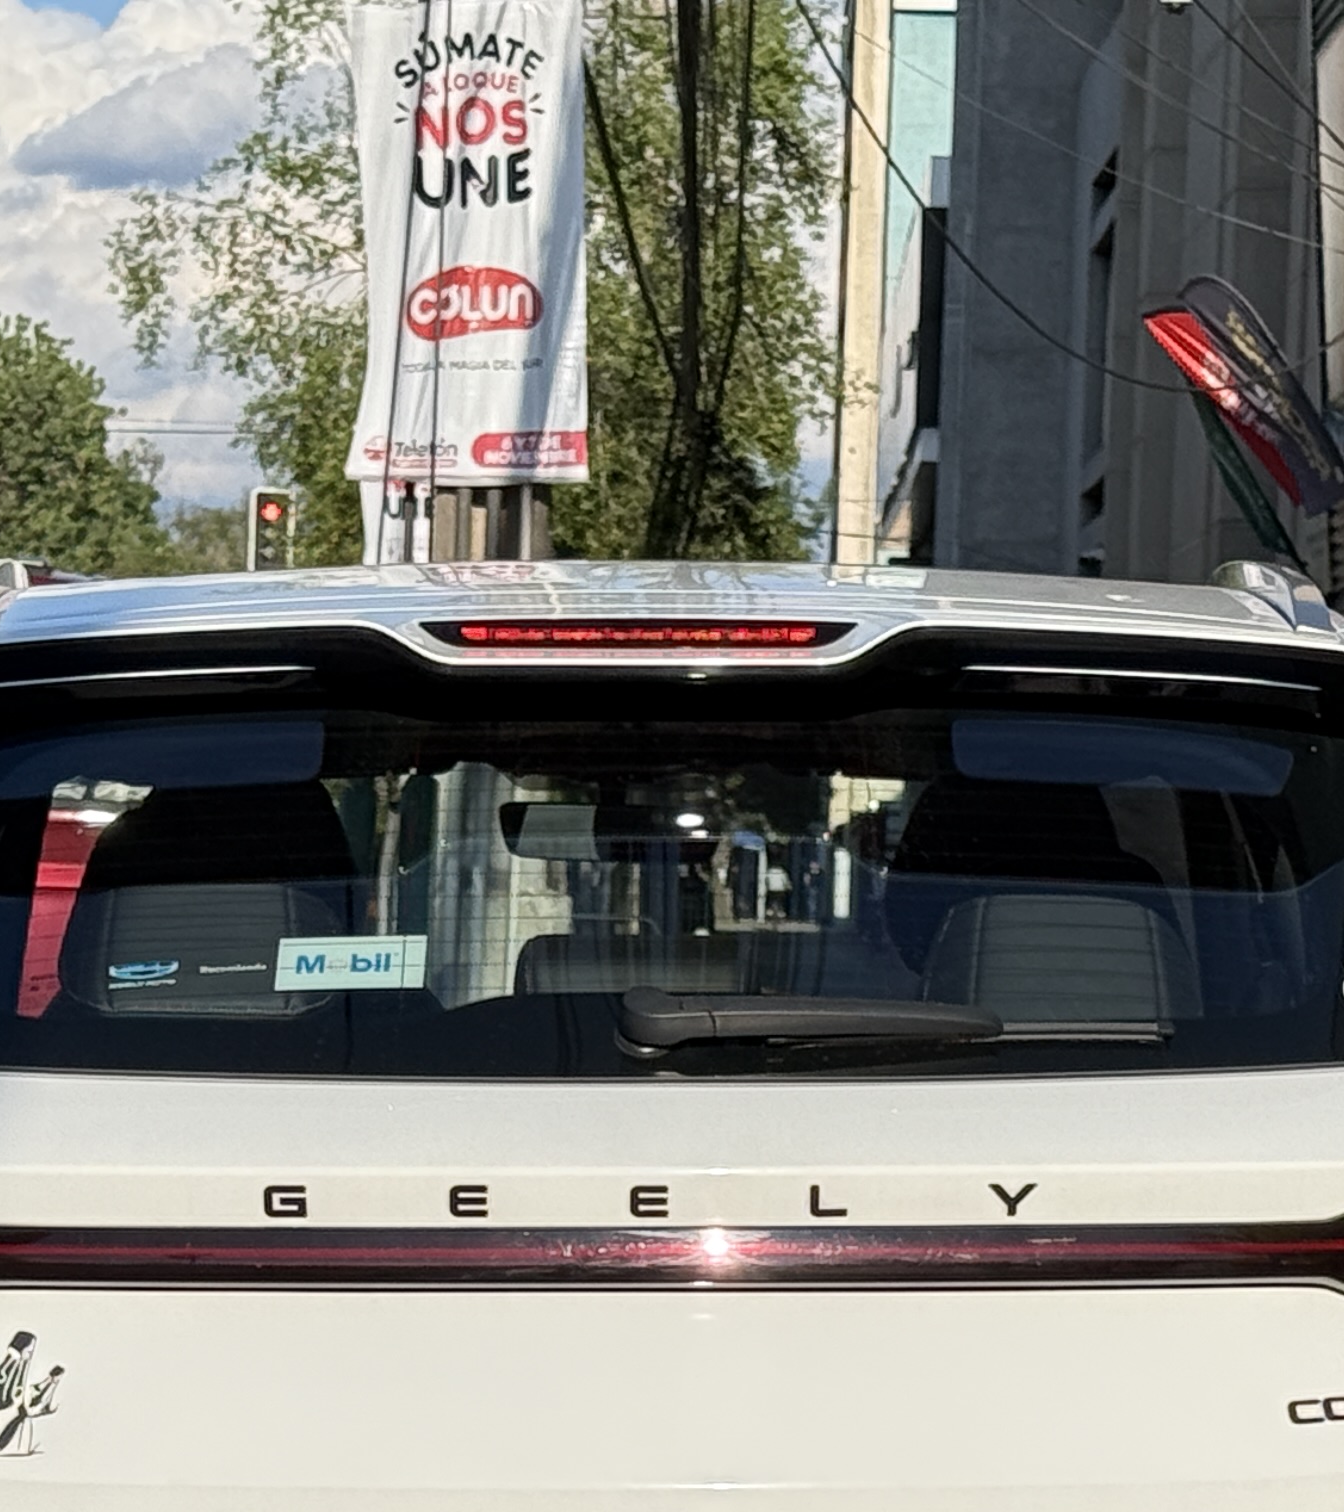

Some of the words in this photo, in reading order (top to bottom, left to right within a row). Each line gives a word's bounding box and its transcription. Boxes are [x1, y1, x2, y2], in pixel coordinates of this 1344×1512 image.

[414, 96, 528, 151] NOS
[413, 147, 533, 210] UNE
[262, 1183, 1038, 1218] GEELY
